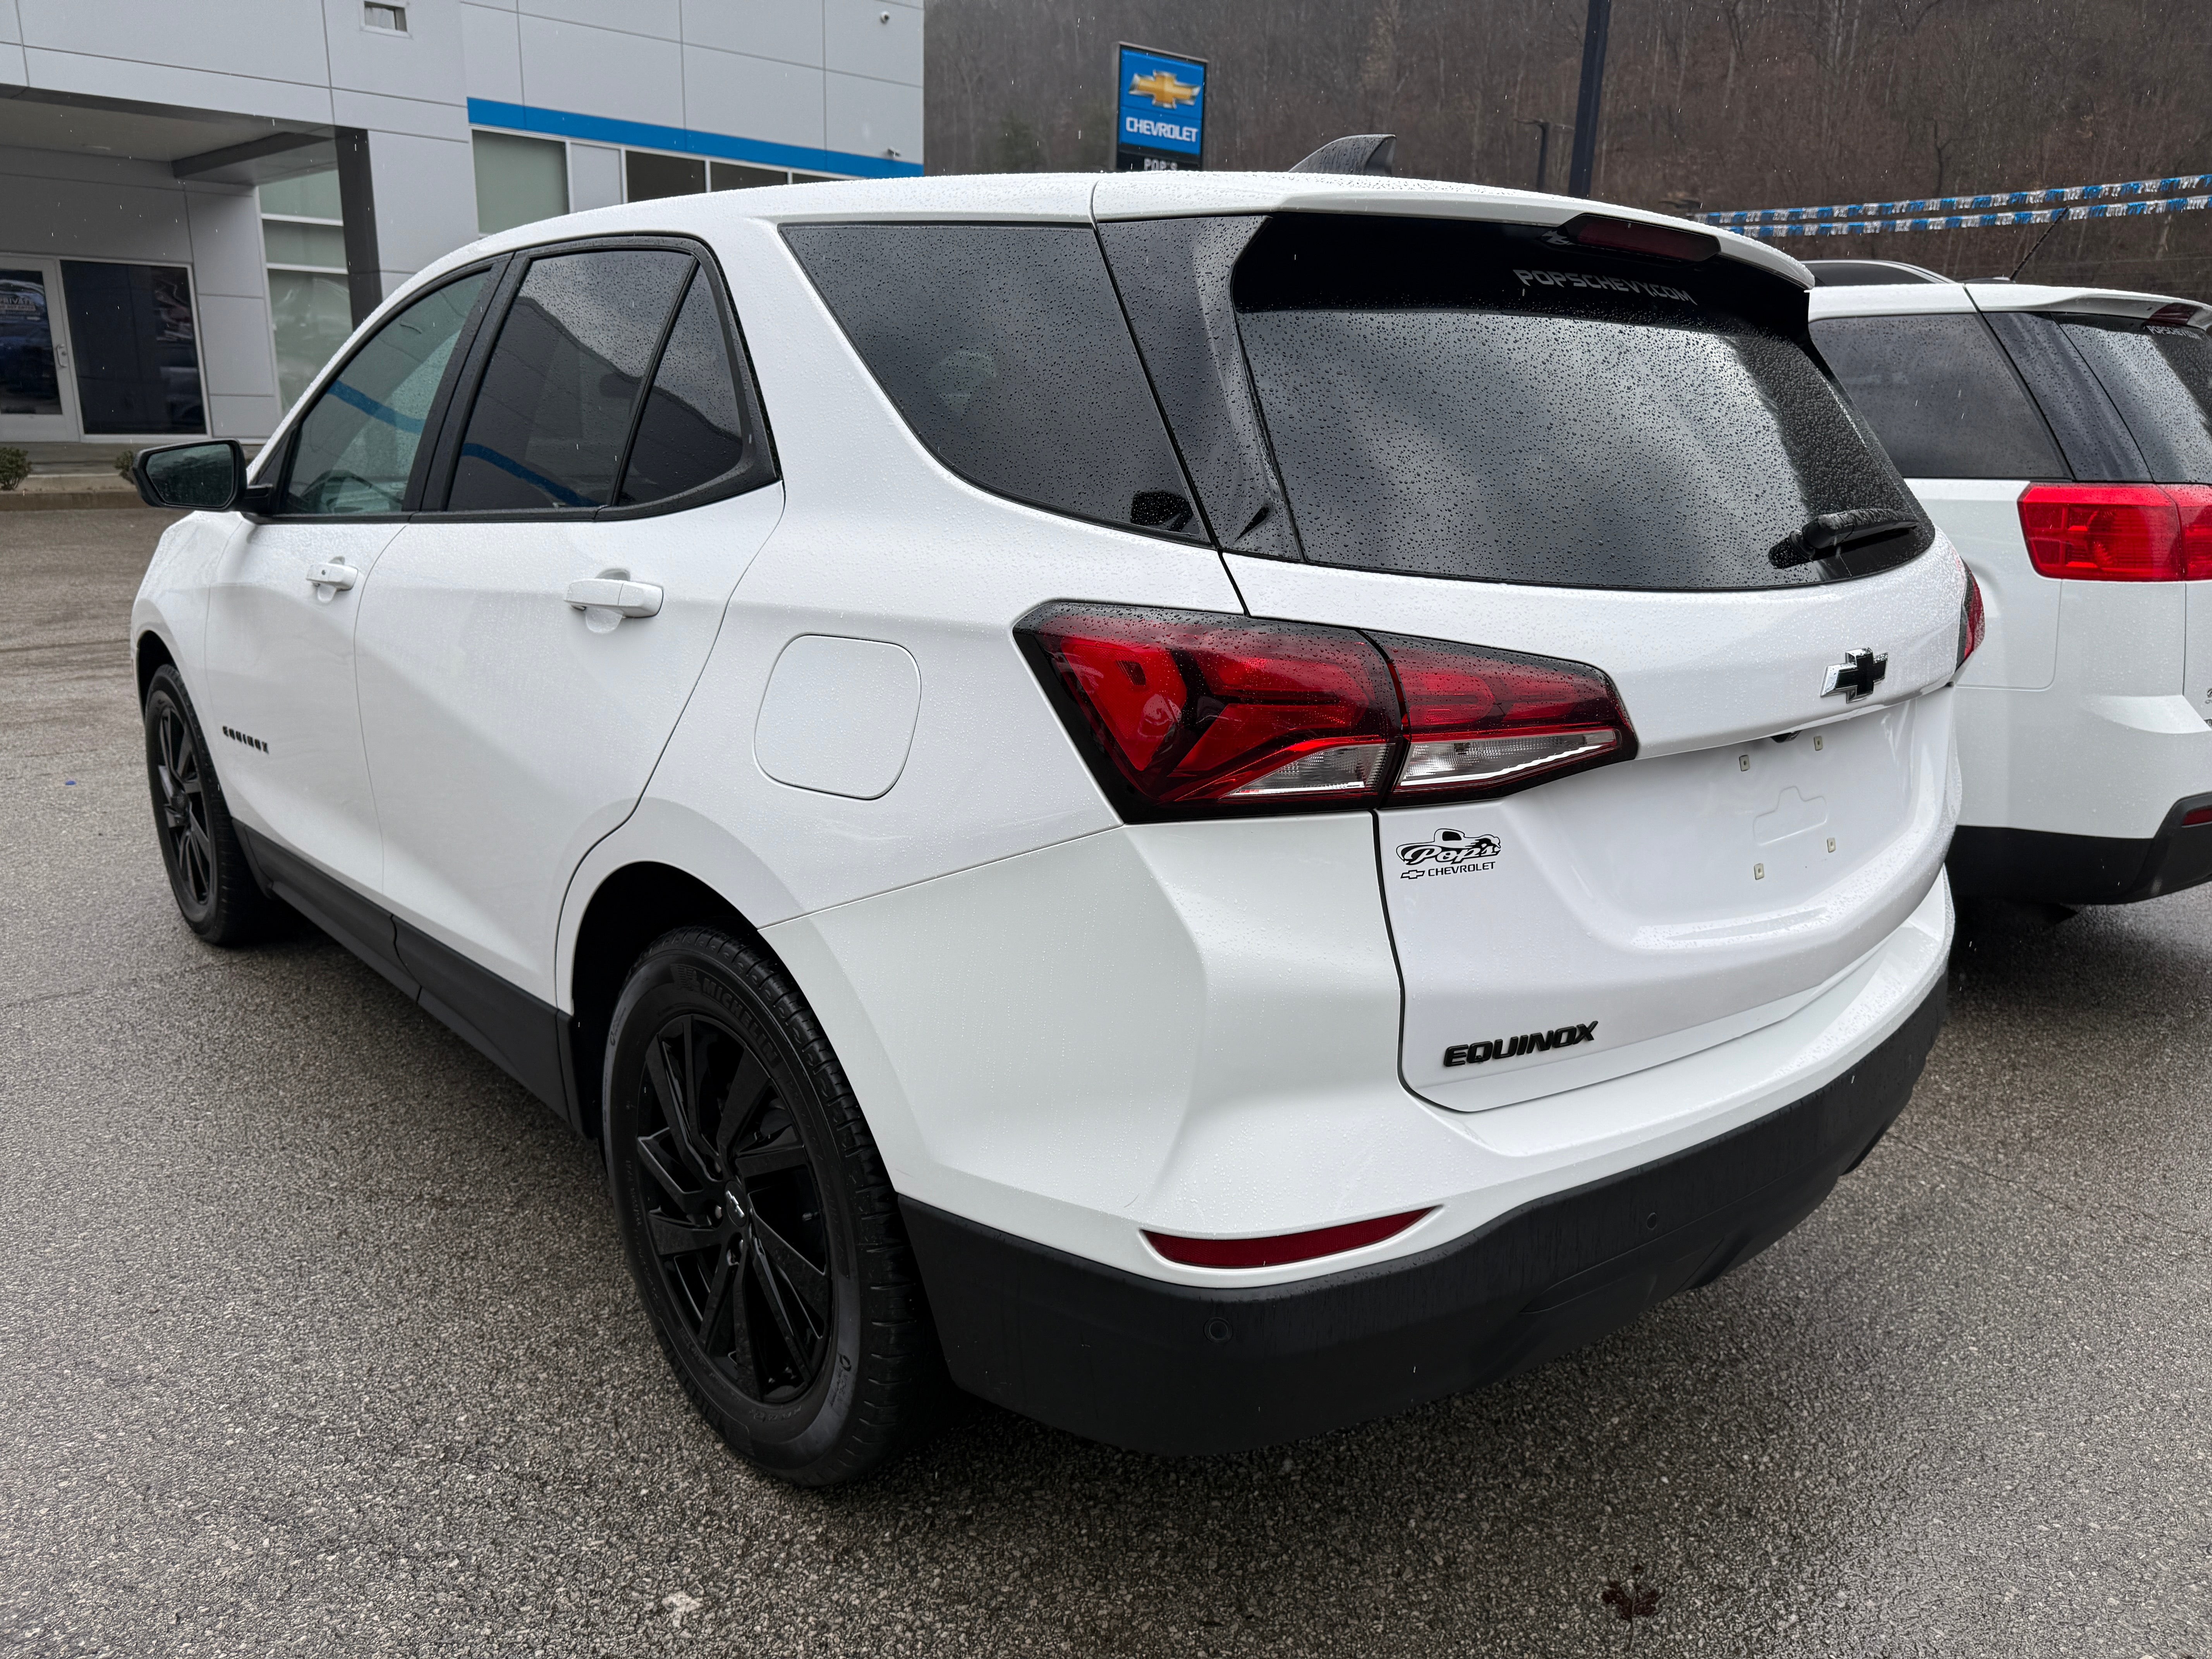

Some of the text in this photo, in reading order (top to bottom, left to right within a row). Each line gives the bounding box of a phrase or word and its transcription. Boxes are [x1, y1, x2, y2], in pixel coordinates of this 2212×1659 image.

[1125, 116, 1198, 142] CHEVROLET
[1513, 270, 1698, 305] POPSCHEVY.COM
[1428, 861, 1496, 876] CHEVROLET
[702, 977, 778, 1062] MICHELIN
[1443, 1020, 1598, 1066] EQUINOX
